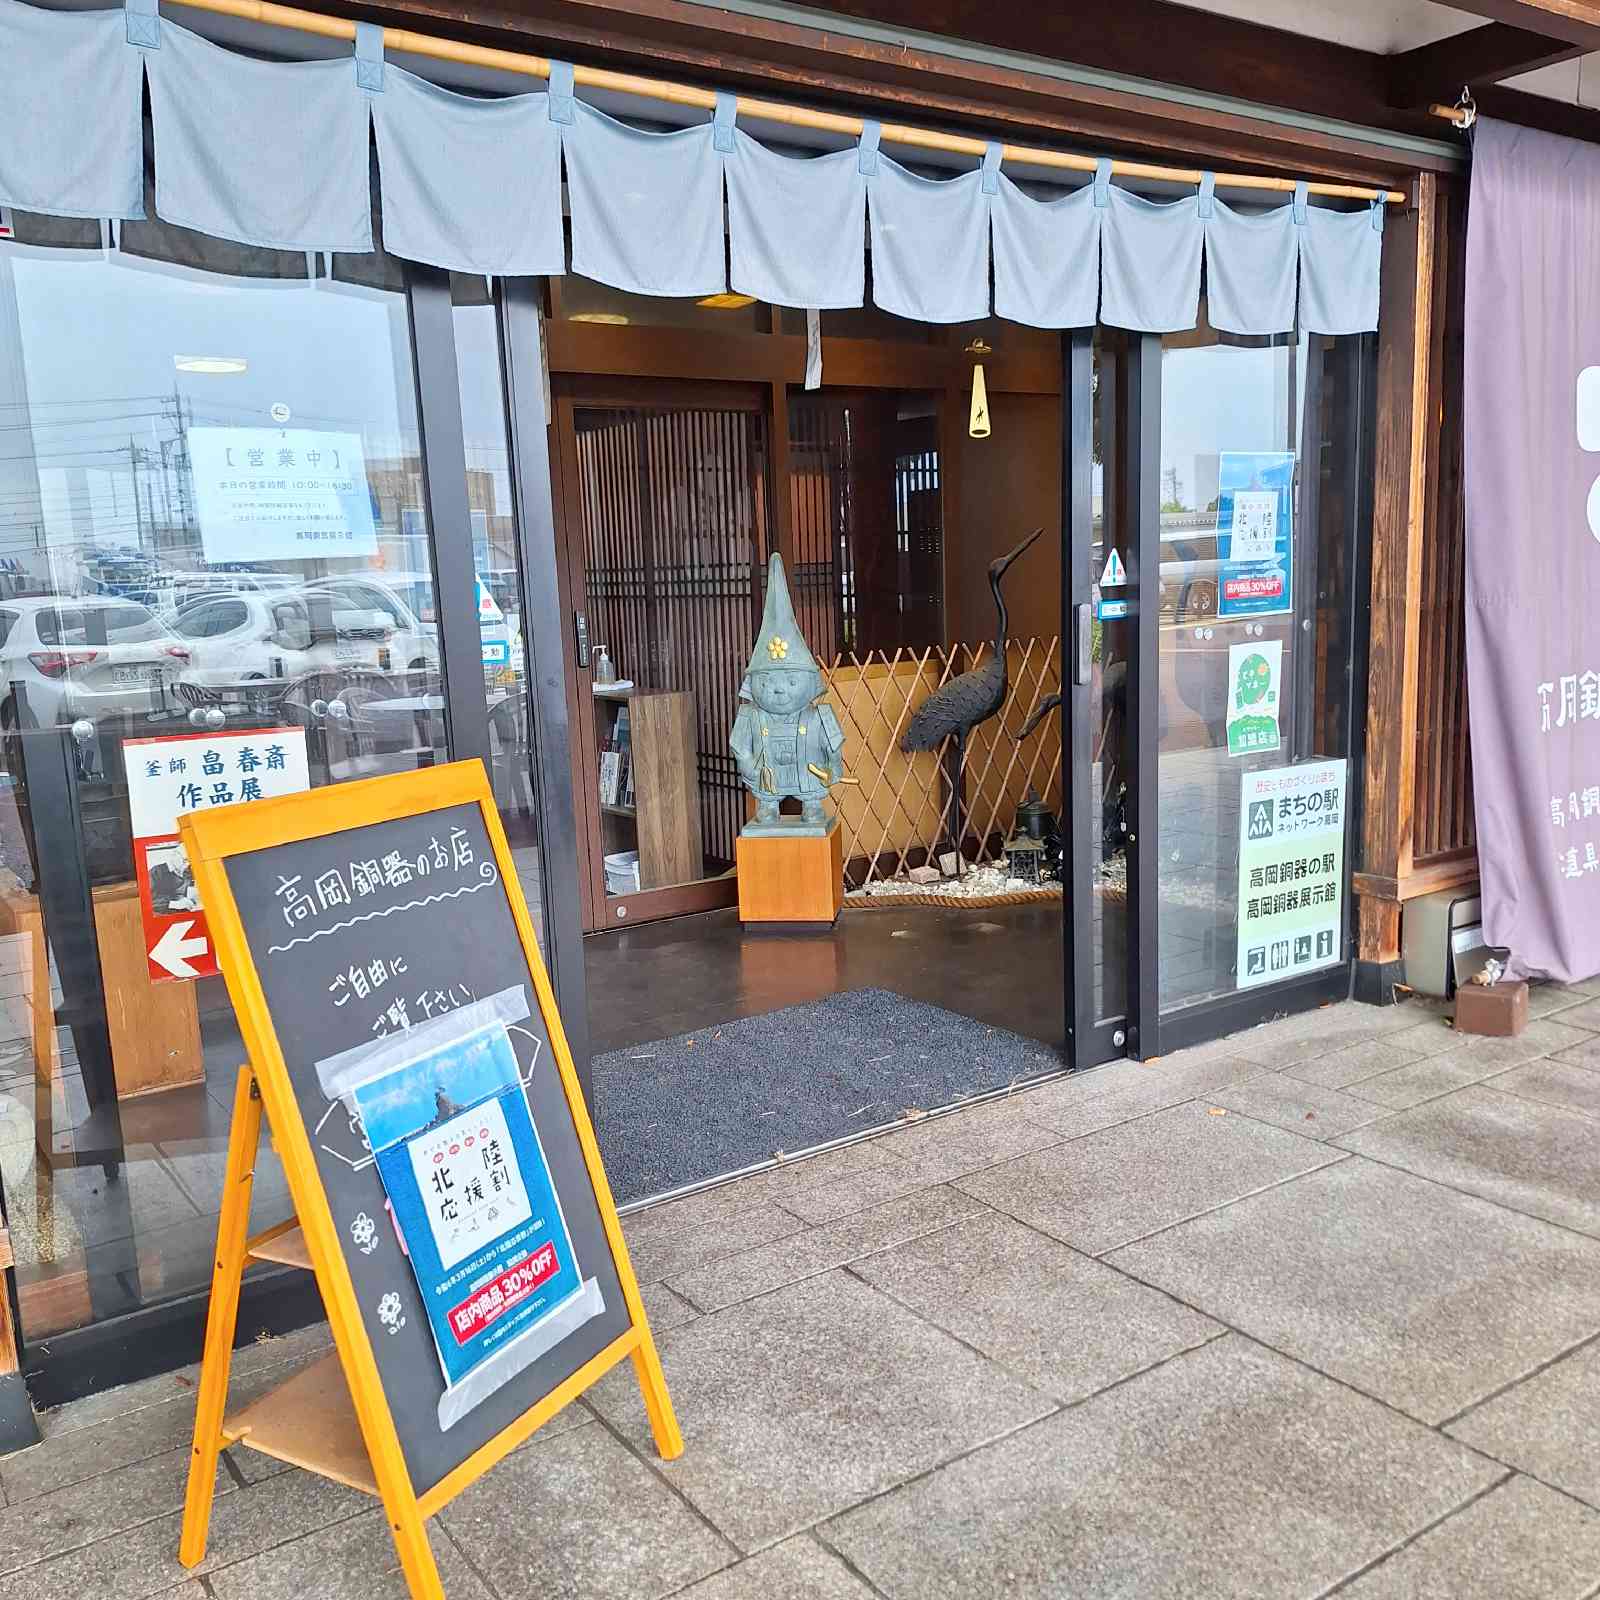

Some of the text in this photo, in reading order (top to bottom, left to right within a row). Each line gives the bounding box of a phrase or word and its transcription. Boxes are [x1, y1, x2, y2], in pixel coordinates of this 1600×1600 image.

[144, 757, 188, 778] 釜師
[176, 777, 265, 808] 作品展
[1279, 787, 1339, 819] まちの駅
[274, 826, 474, 928] 高岡銅器のお店
[1250, 852, 1335, 889] 高岡銅器の駅
[1247, 881, 1337, 921] 高岡銅器展示館
[328, 956, 409, 1007] ご自由に
[440, 1165, 511, 1222] 応援割
